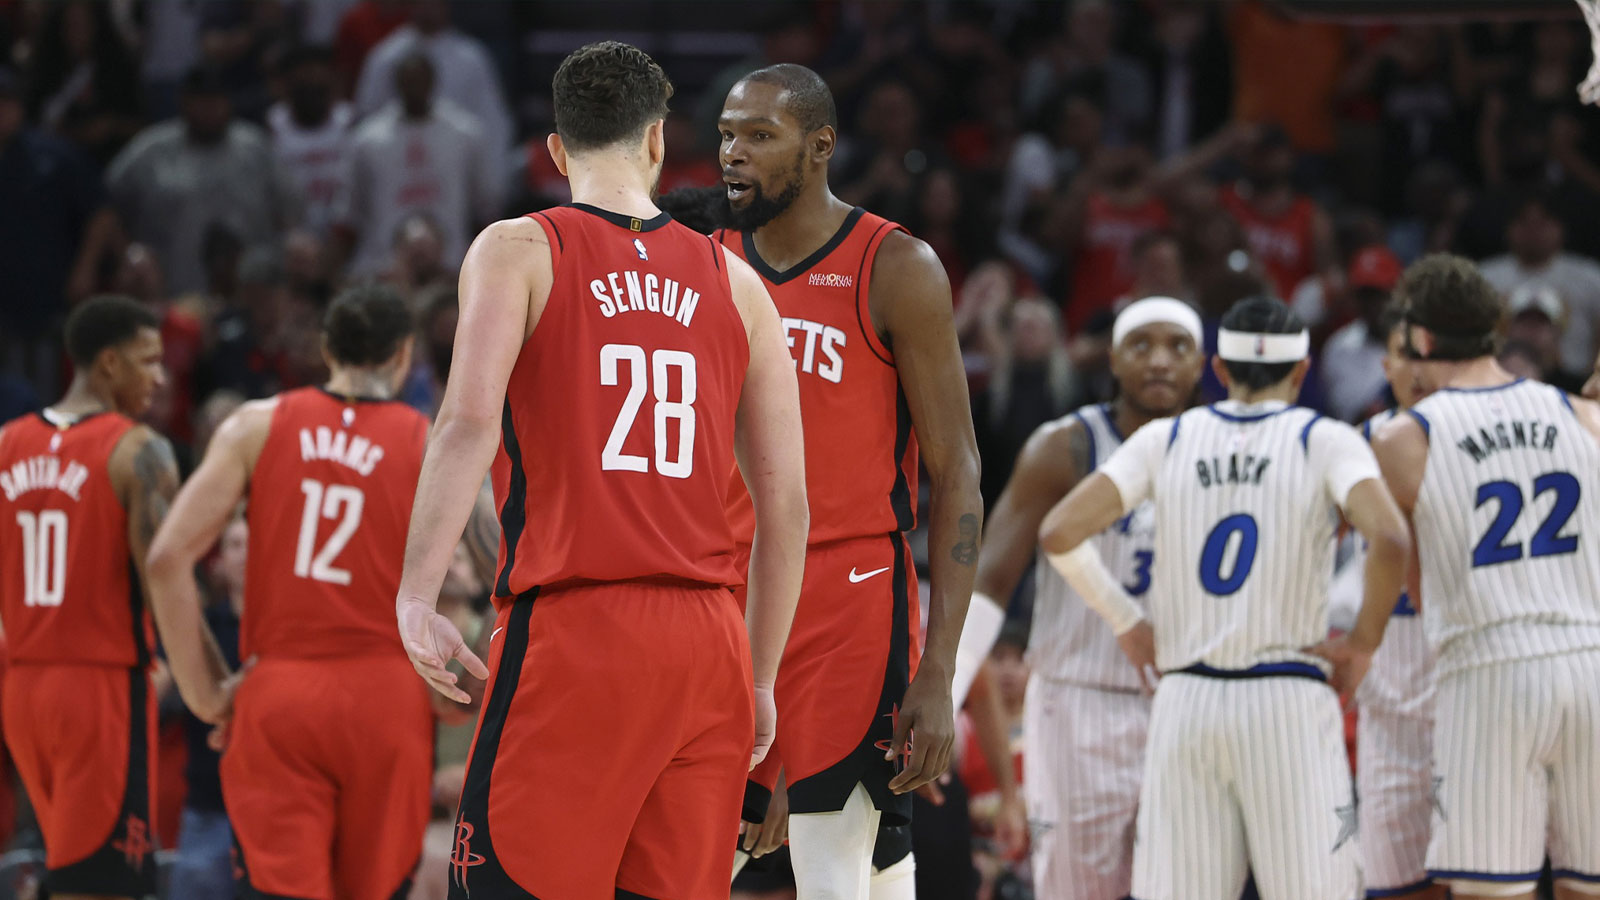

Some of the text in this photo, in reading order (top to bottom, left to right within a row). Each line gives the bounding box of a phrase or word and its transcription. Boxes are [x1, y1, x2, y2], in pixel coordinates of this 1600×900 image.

[590, 271, 700, 328] SENGUN
[808, 279, 852, 287] HERMANN
[809, 272, 852, 281] MEMORIAL
[599, 344, 697, 479] 28
[299, 426, 384, 476] ADAMS
[1457, 420, 1558, 464] WAGNER
[0, 455, 60, 502] SMITH
[1196, 453, 1270, 489] BLACK
[294, 479, 365, 586] 12
[1471, 471, 1581, 568] 22
[16, 509, 68, 607] 10
[1199, 513, 1258, 597] 0
